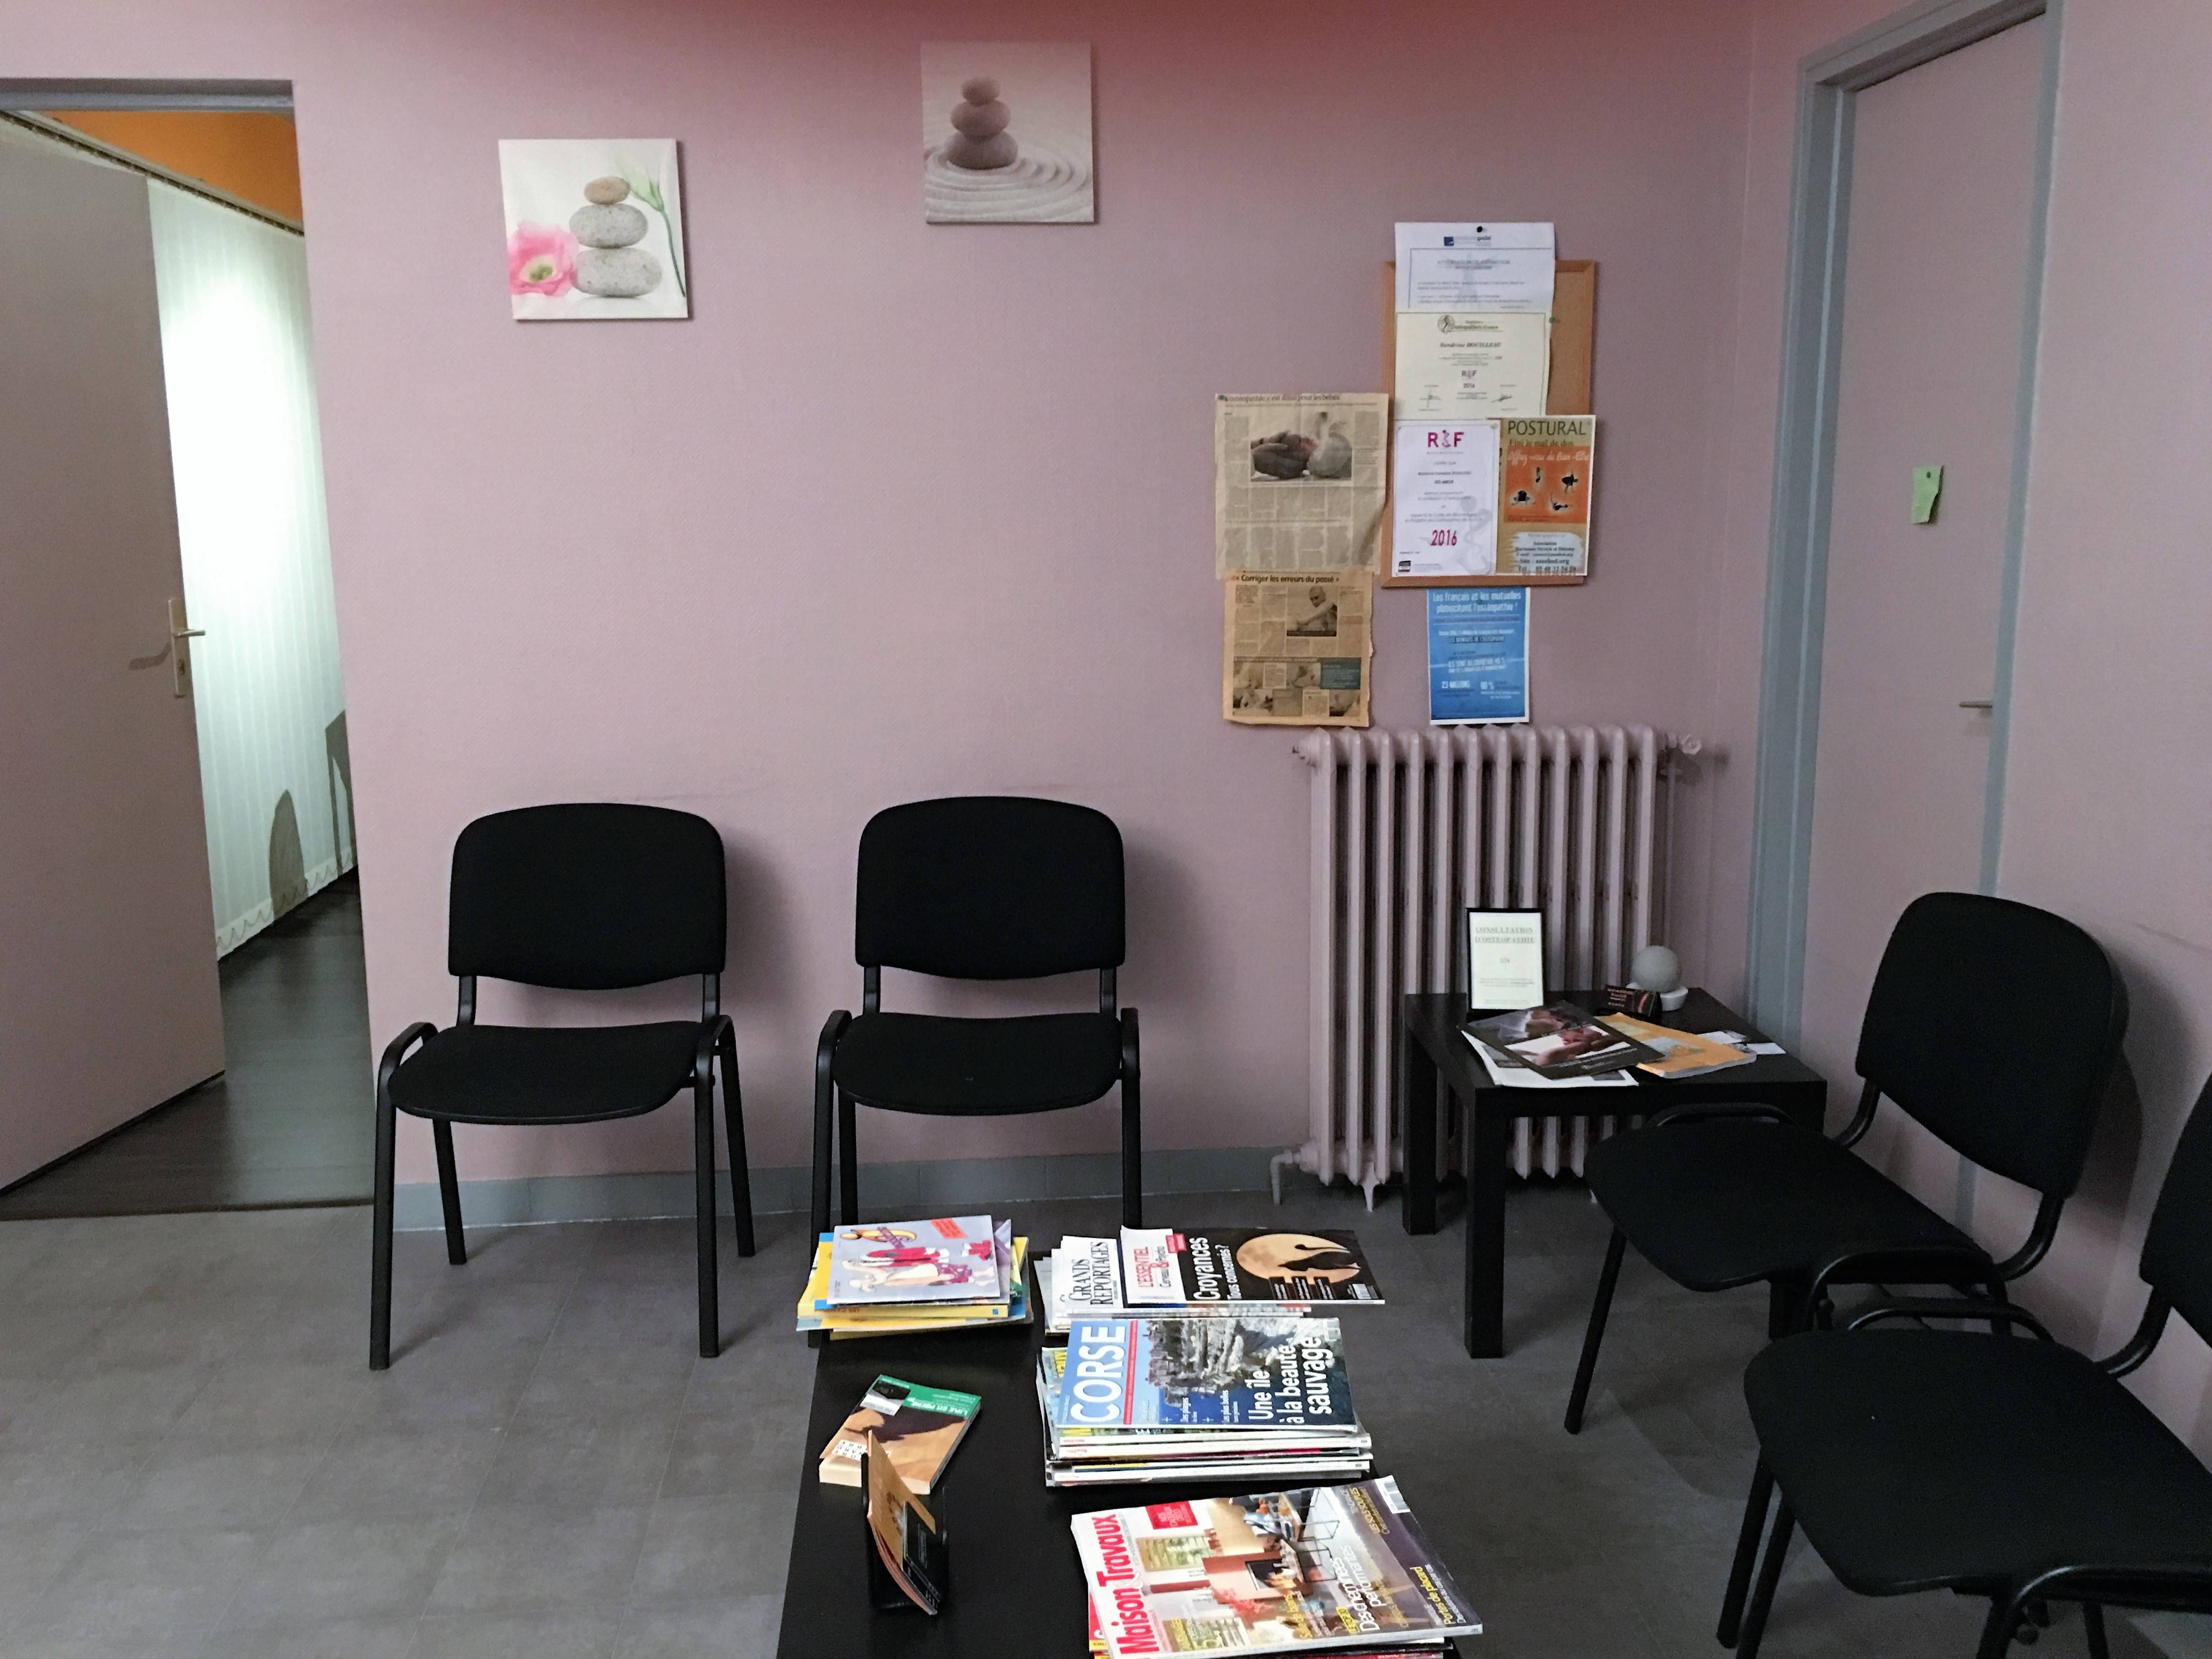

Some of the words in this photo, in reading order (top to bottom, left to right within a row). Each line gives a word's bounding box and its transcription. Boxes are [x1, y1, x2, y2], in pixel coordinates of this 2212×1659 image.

[1508, 420, 1587, 436] POSTURAL
[1431, 530, 1457, 546] 2016
[1241, 575, 1268, 583] Corriger
[1433, 593, 1443, 602] Les
[1068, 1258, 1093, 1301] GRANDS
[1090, 1241, 1113, 1305] REPORTAGES
[1133, 1246, 1154, 1288] L'ESSENTIEL
[1189, 1237, 1223, 1300] Croyances
[1227, 1283, 1242, 1300] Tous
[1070, 1326, 1126, 1423] CORSE
[1245, 1370, 1271, 1390] île
[1274, 1344, 1301, 1397] beauté
[1300, 1336, 1333, 1415] sauvage
[1248, 1392, 1275, 1420] Une
[1276, 1401, 1303, 1414] la
[1091, 1513, 1135, 1588] Travaux
[1332, 1556, 1369, 1616] cheminées
[1342, 1545, 1387, 1608] performantes
[1409, 1566, 1439, 1591] placard
[1427, 1591, 1441, 1602] de
[1110, 1587, 1160, 1654] Maison
[1358, 1612, 1381, 1632] Des
[1435, 1602, 1457, 1624] Portes
